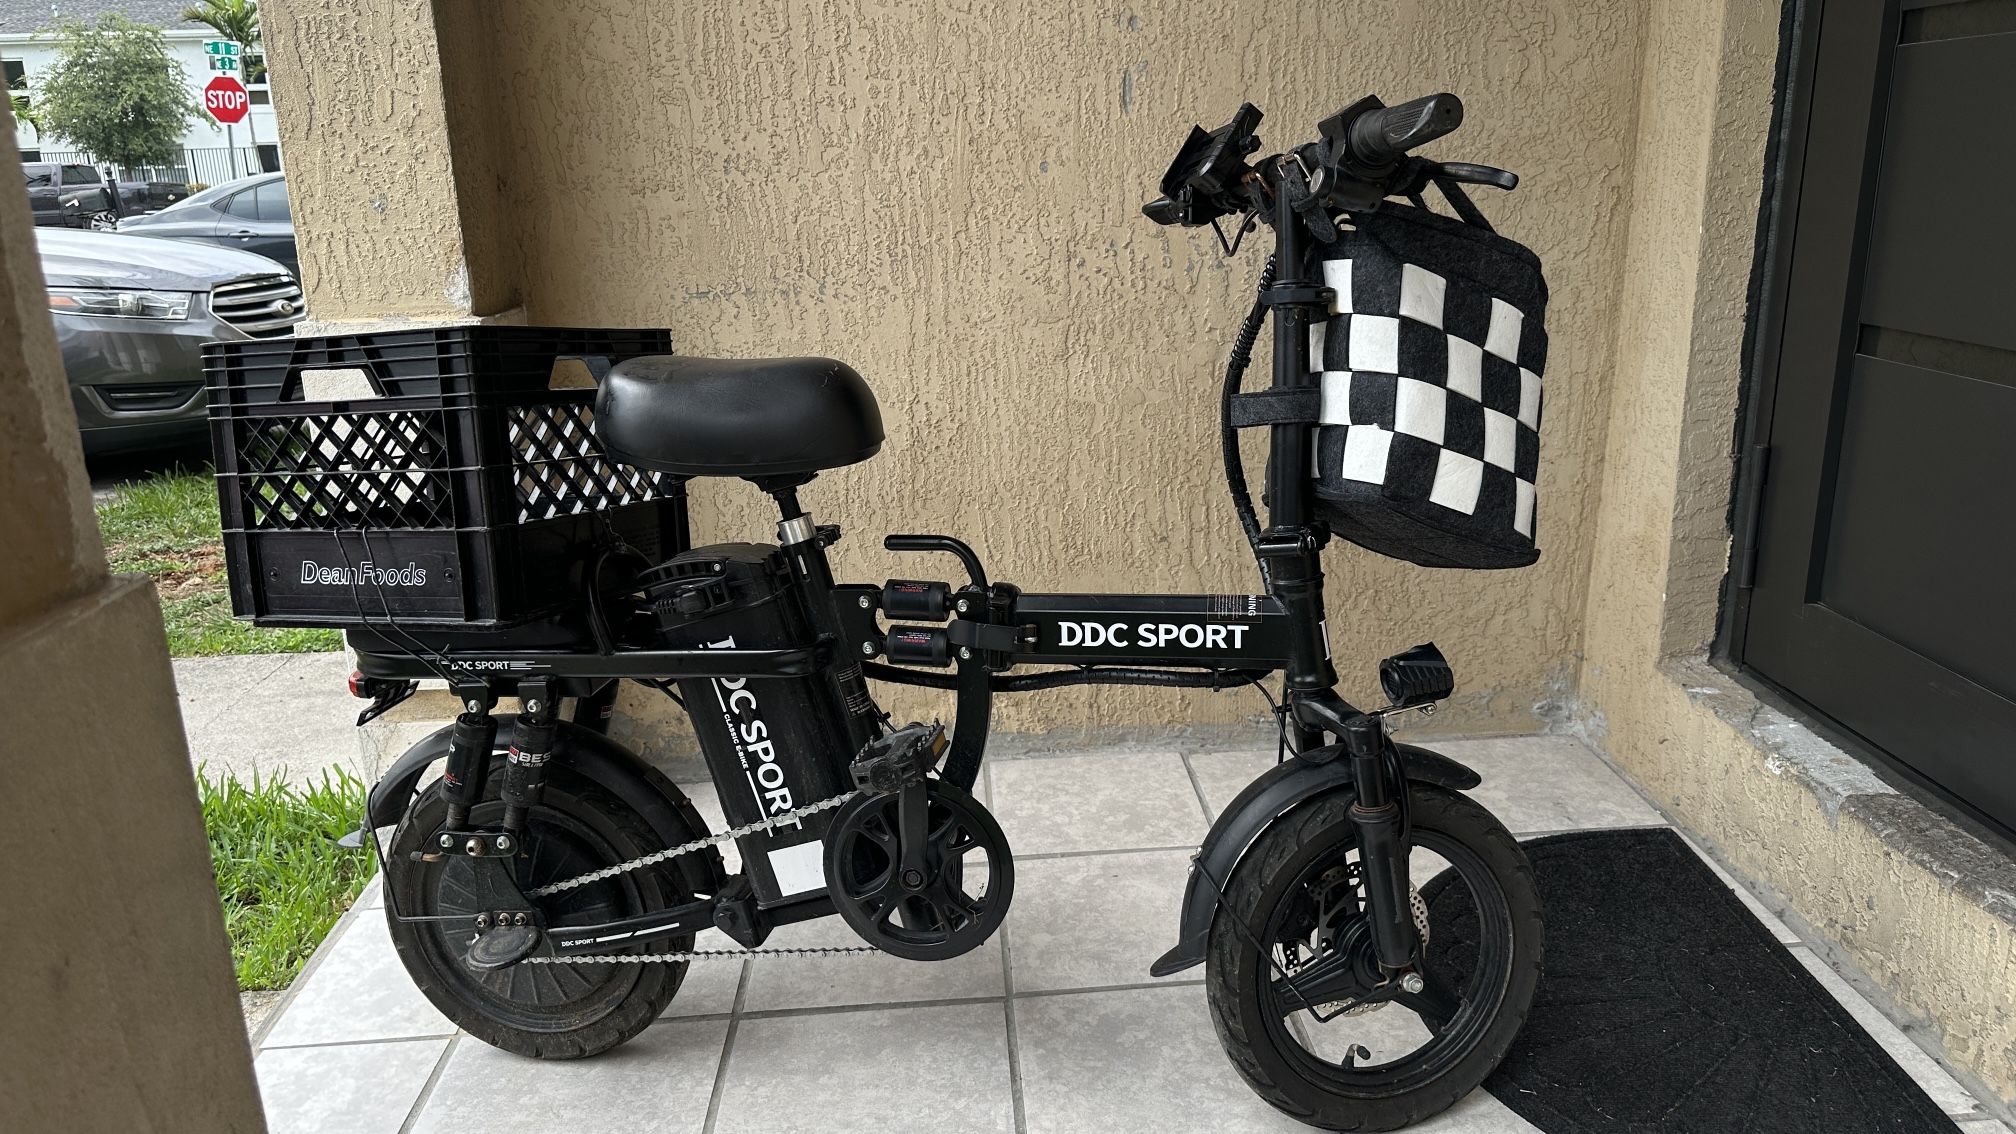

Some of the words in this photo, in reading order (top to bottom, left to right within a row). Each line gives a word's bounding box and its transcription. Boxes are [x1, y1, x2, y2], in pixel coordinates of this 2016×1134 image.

[204, 44, 213, 53] NE
[219, 42, 225, 54] 11
[230, 46, 238, 55] ST
[224, 57, 230, 69] 3
[207, 90, 245, 109] STOP
[300, 560, 427, 586] DeanFoods
[1058, 621, 1128, 648] DDC
[1137, 623, 1249, 649] SPORT
[451, 661, 474, 670] DDC
[474, 661, 509, 670] SPORT
[723, 714, 740, 744] CLASSIC
[735, 745, 749, 770] E-BIKE
[740, 719, 803, 831] SPORT
